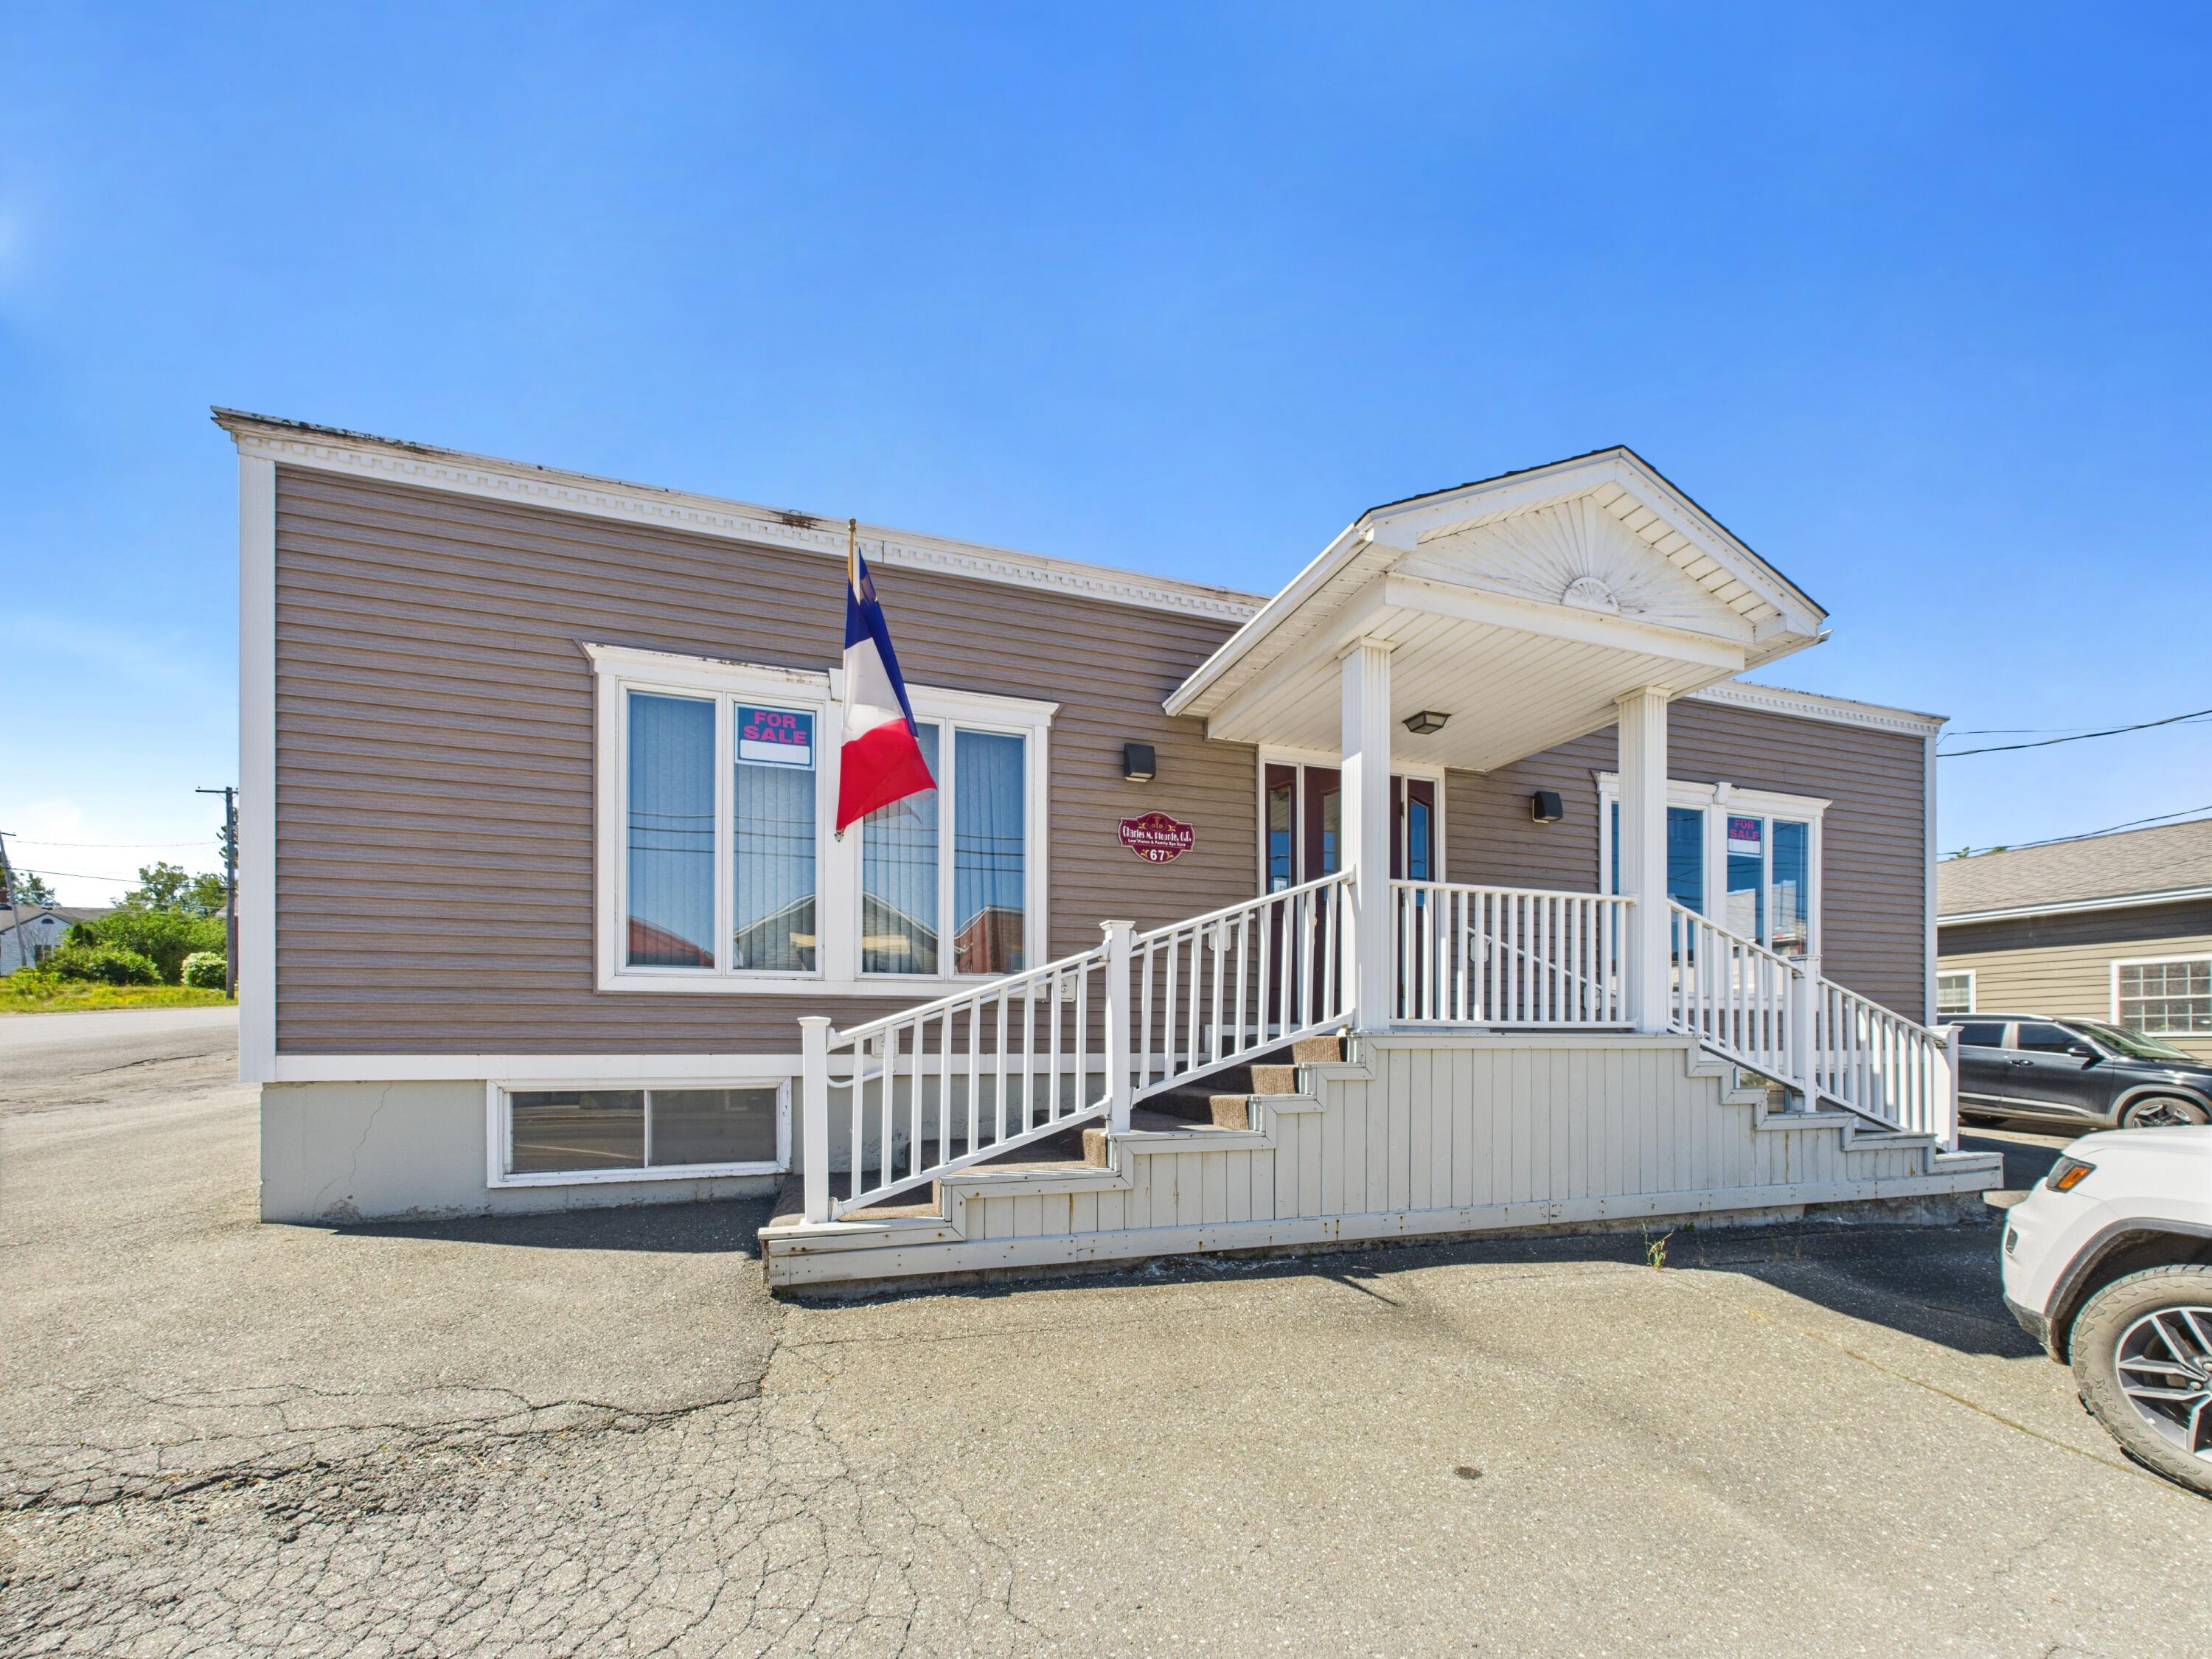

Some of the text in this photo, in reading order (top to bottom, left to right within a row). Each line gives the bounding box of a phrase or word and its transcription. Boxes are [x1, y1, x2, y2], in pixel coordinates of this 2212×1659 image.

[754, 711, 796, 728] FOR
[743, 726, 807, 744] SALE
[1734, 819, 1754, 830] FOR
[1123, 826, 1144, 838] Charles
[1730, 829, 1759, 841] SALE
[1150, 849, 1164, 860] 67
